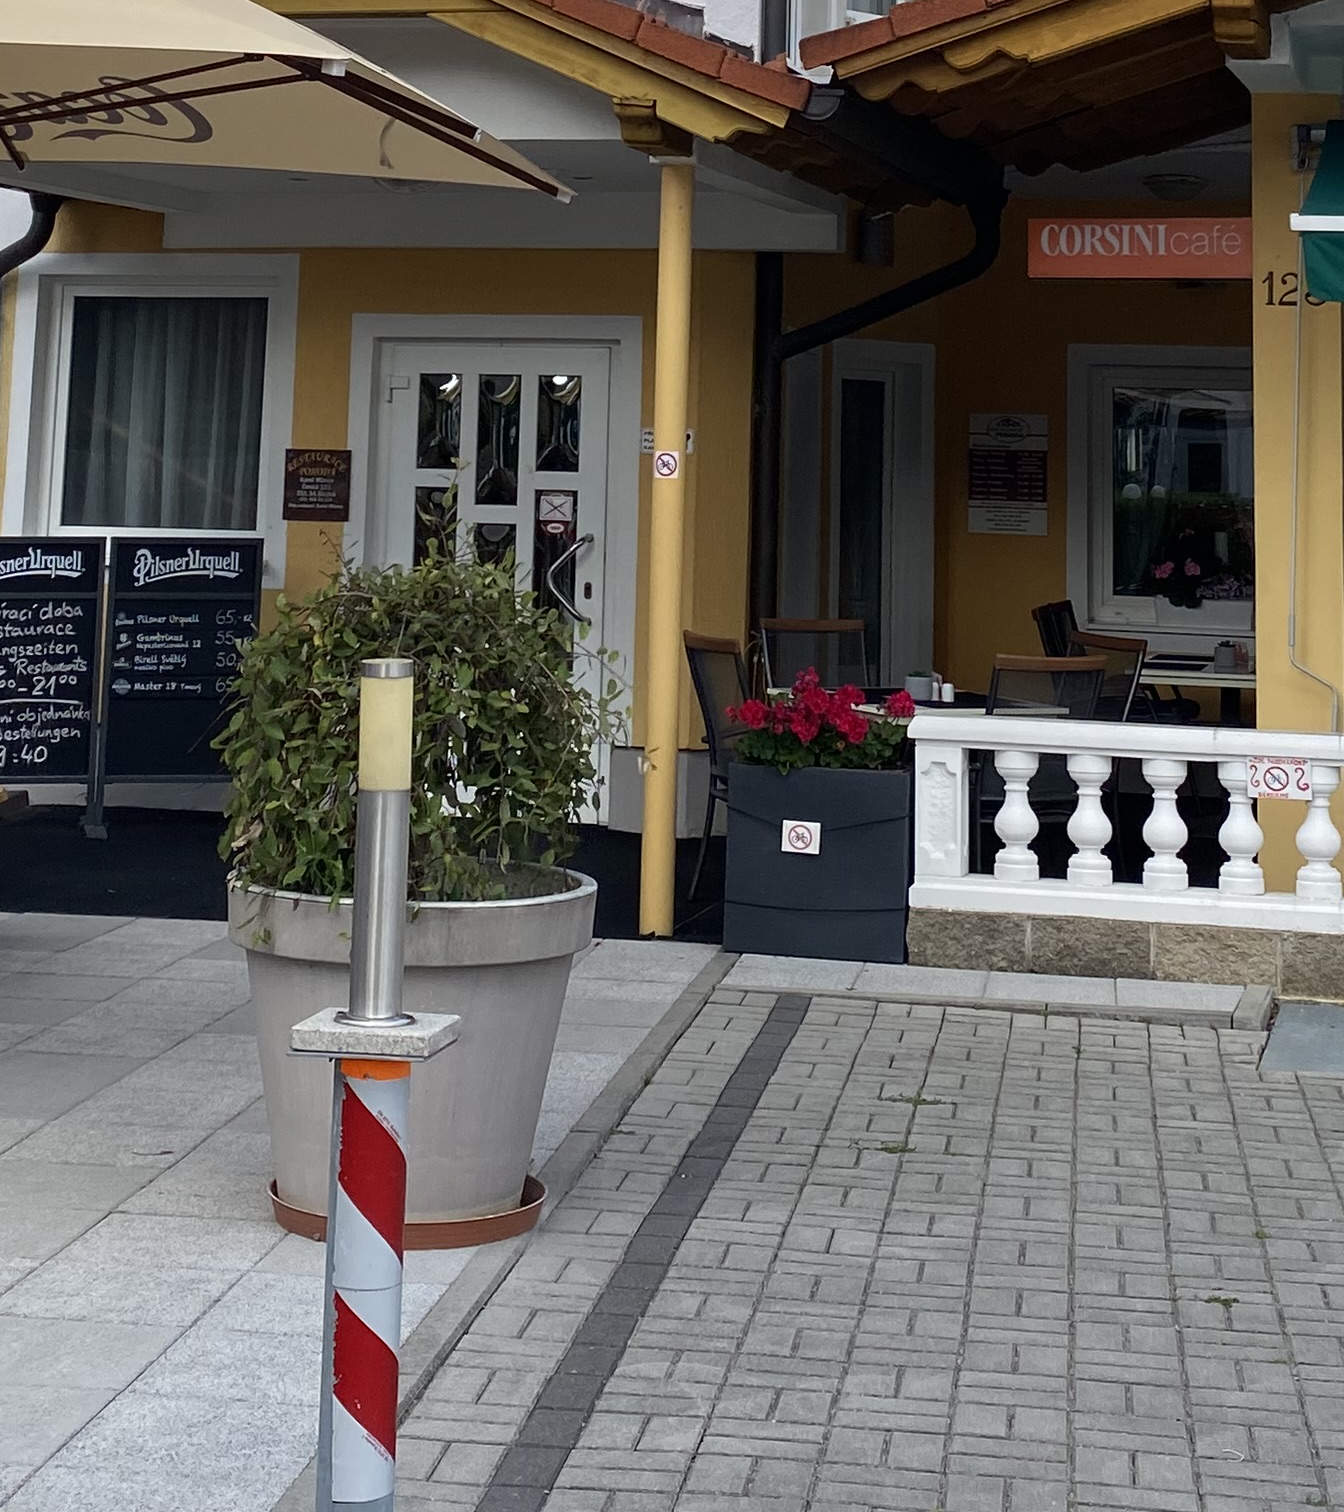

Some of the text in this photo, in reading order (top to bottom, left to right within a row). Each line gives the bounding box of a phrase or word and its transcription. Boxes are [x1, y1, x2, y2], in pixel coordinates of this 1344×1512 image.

[1041, 223, 1242, 257] CORSINI café
[28, 547, 83, 579] Urquell
[133, 547, 240, 587] Pilsner Urquell
[39, 601, 83, 621] doba
